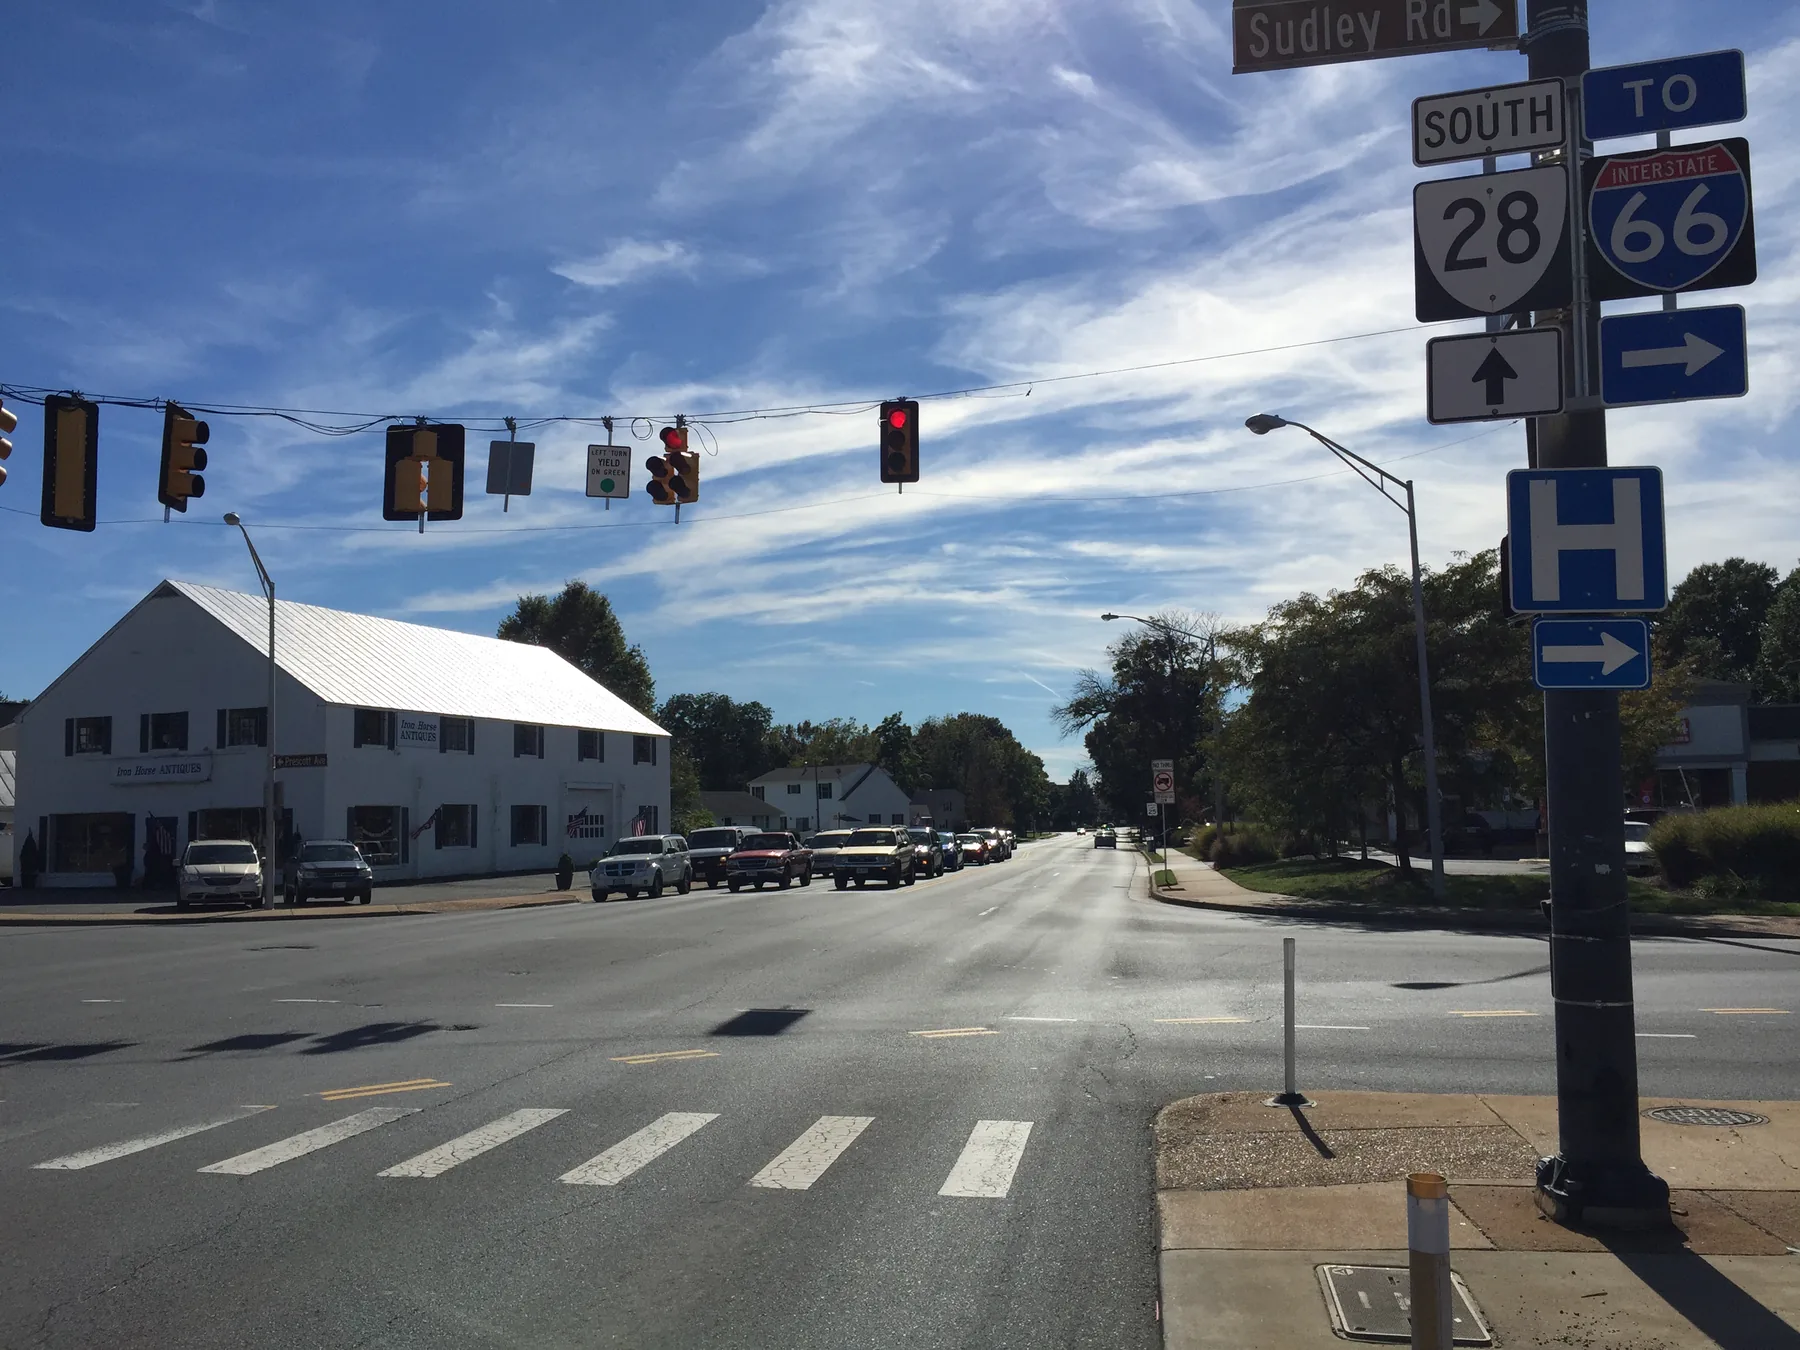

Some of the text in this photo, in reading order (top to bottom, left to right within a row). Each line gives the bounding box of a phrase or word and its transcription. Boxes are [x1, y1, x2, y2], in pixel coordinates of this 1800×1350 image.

[1249, 0, 1451, 58] Sudley Rd
[1622, 74, 1697, 117] TO
[1424, 94, 1553, 148] SOUTH
[1612, 154, 1718, 185] INTERSTATE
[1443, 190, 1541, 272] 28
[1610, 182, 1729, 264] 66
[598, 458, 620, 467] YIELD
[1529, 477, 1645, 601] H
[401, 719, 437, 731] Iron Horse
[401, 731, 437, 741] ANTIQUES
[116, 763, 202, 777] Iron Horse ANTIQUES
[285, 756, 326, 766] Prescott Ave
